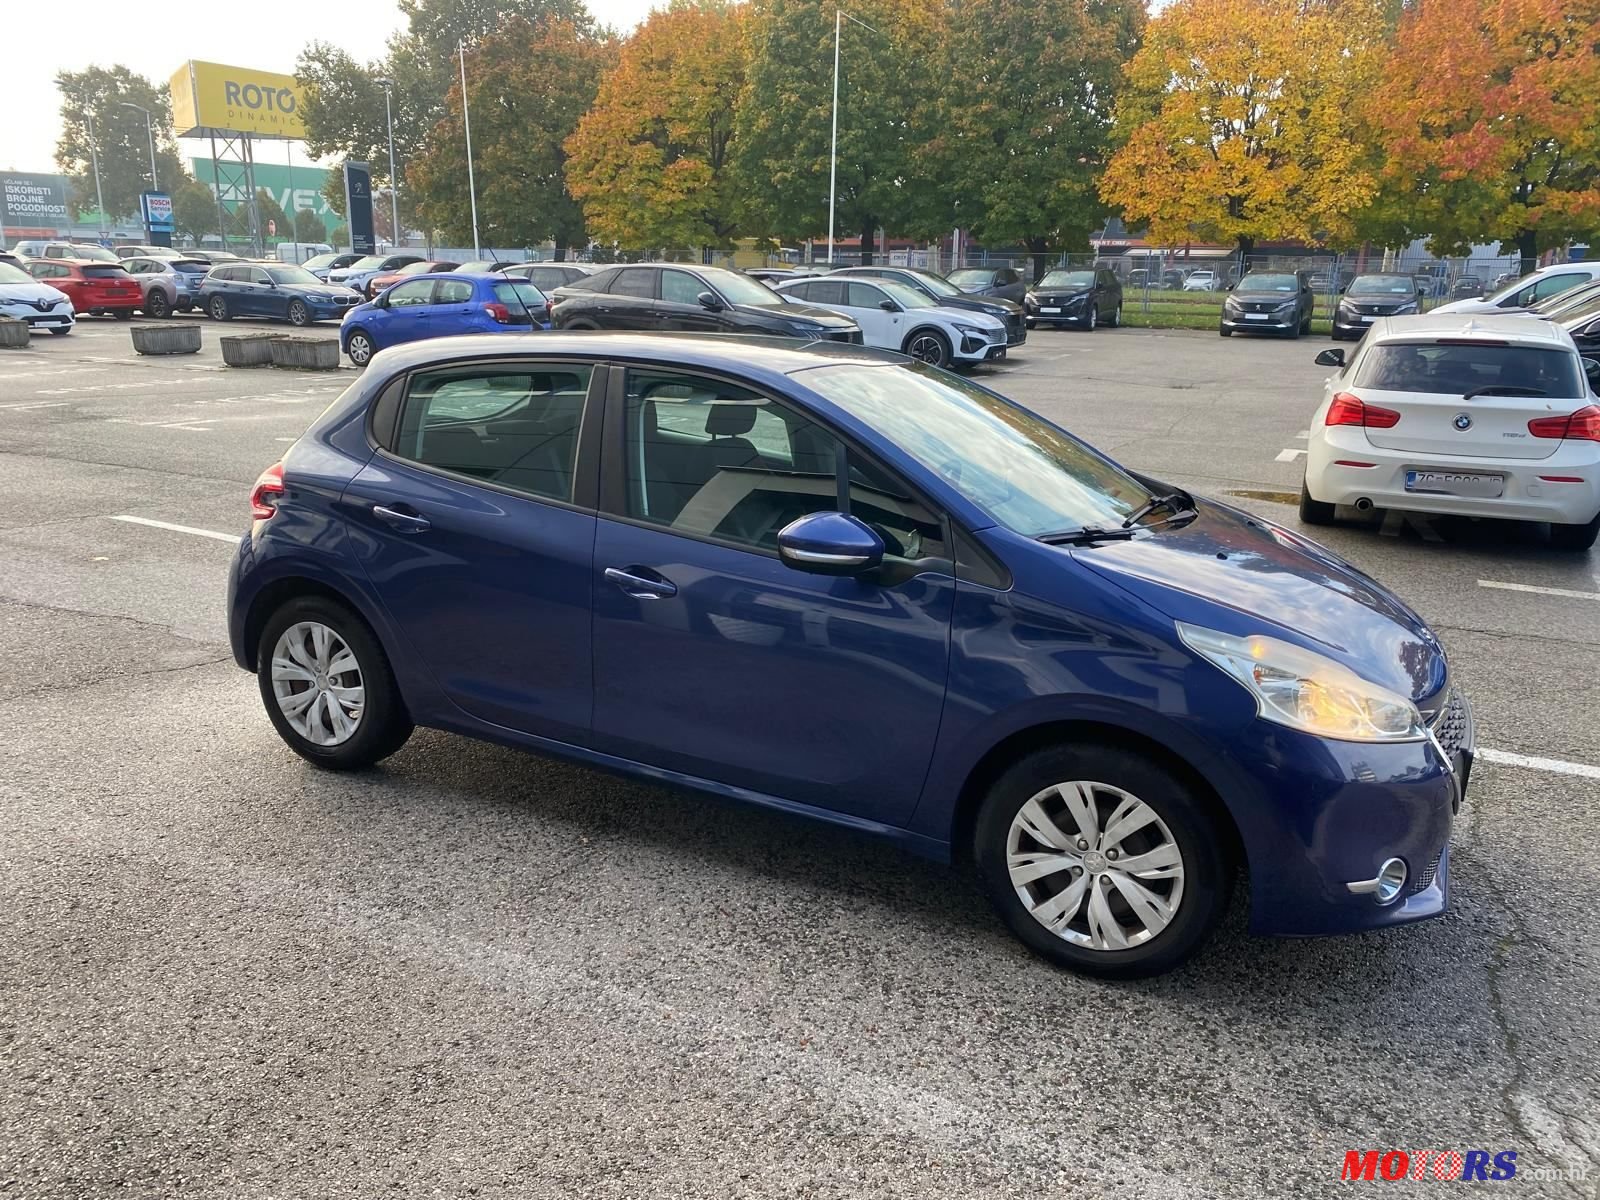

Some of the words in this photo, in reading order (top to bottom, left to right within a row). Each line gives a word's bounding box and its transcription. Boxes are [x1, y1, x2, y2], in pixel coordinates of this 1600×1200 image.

[224, 81, 296, 113] ROTO
[228, 109, 296, 126] DINAMIC
[4, 185, 51, 195] ISKORISTI
[6, 194, 45, 204] BROJNE
[7, 202, 67, 213] POGODNOST
